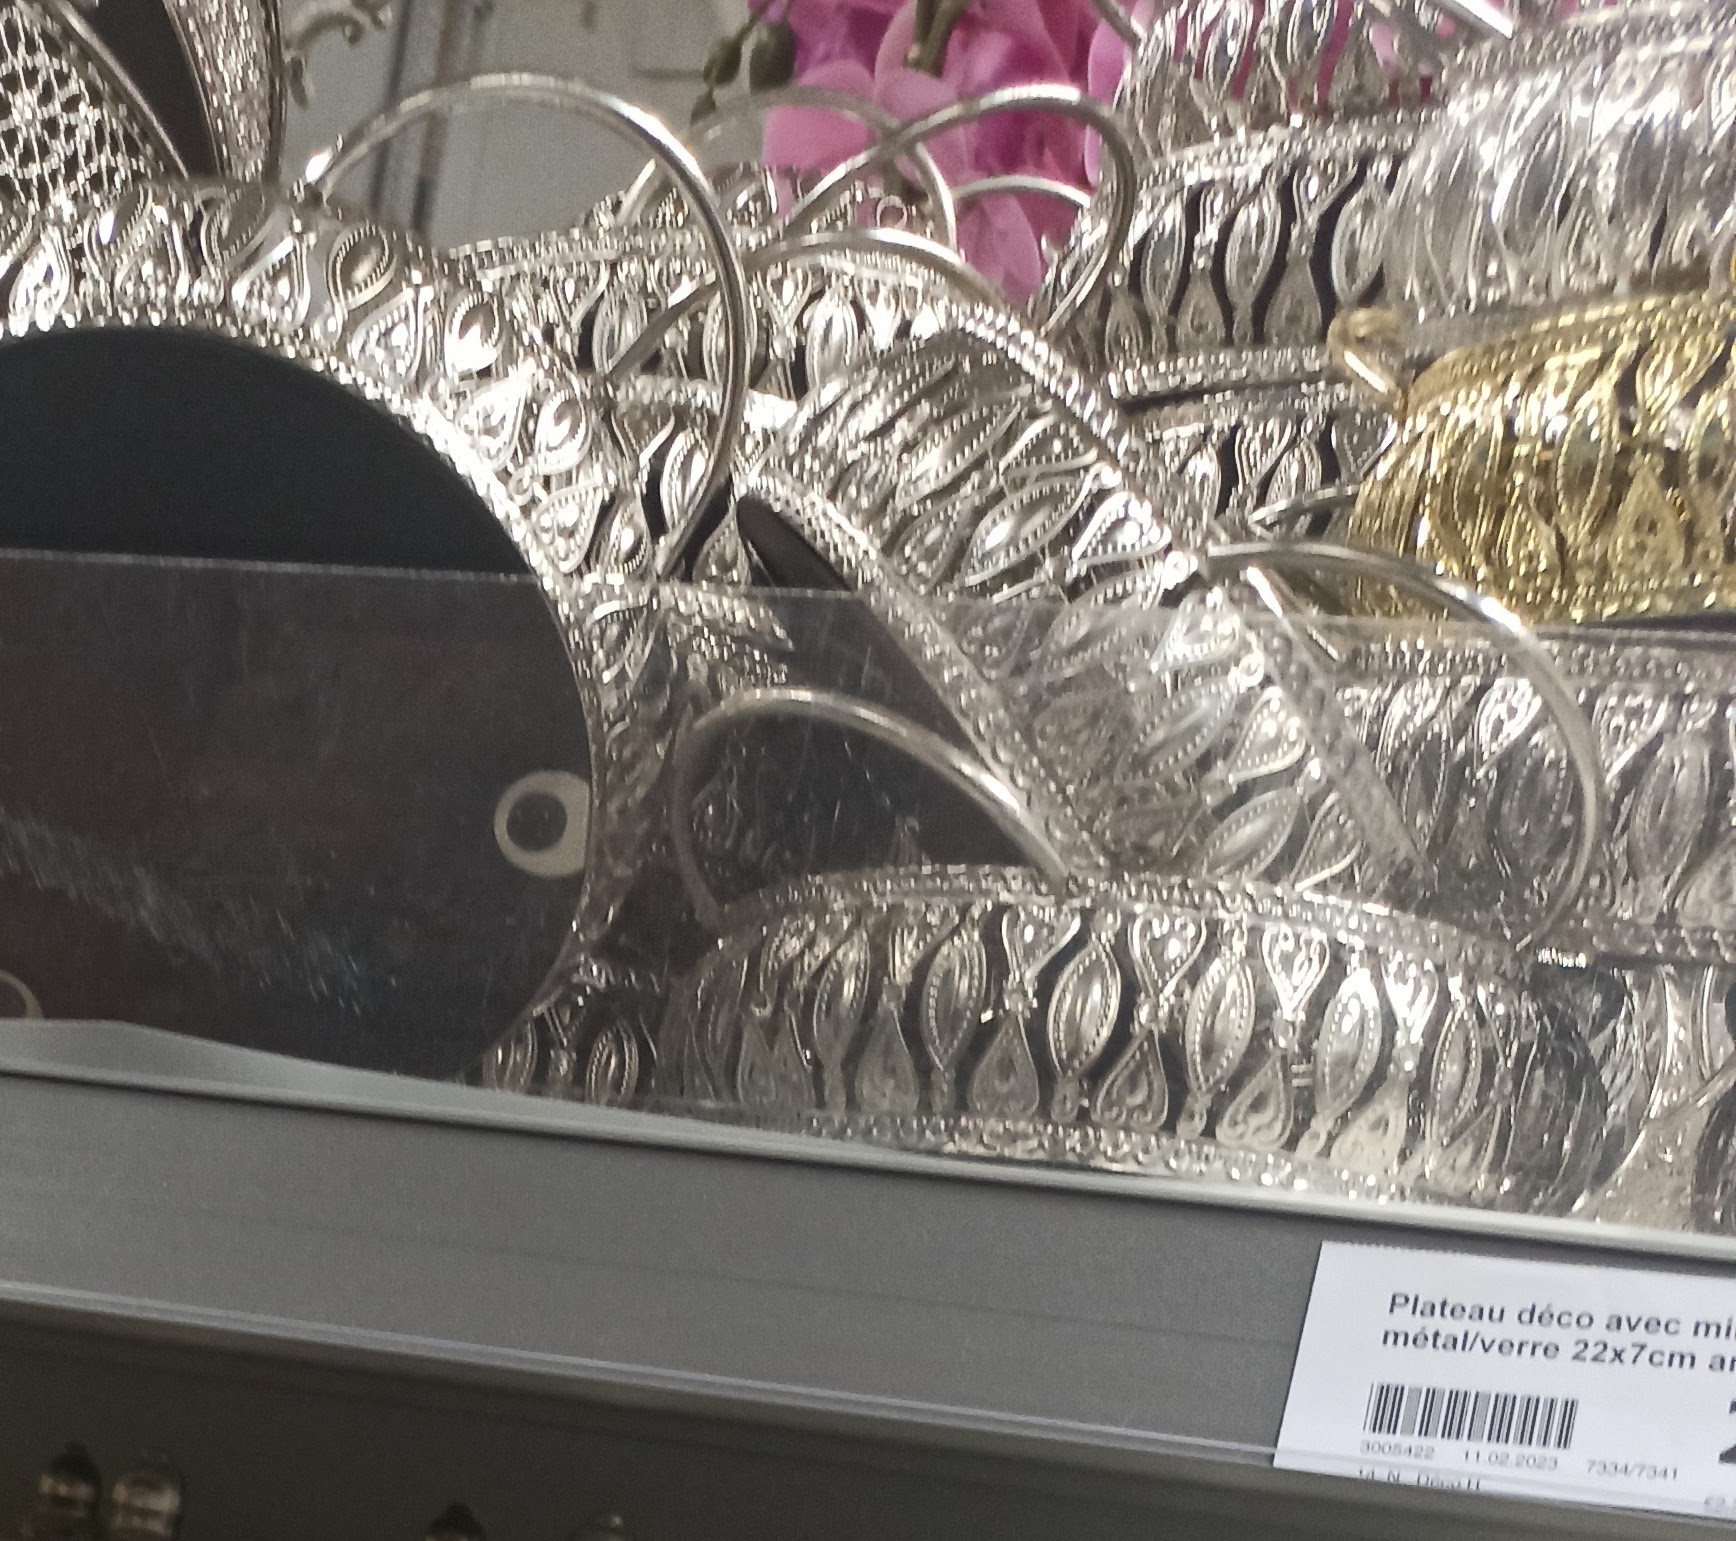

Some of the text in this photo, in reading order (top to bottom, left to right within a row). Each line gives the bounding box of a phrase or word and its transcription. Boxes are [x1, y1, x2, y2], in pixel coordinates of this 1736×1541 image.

[1388, 1292, 1736, 1340] Plateau déco avec mi
[1382, 1327, 1560, 1360] métal/verre
[1571, 1339, 1696, 1370] 22x7cm
